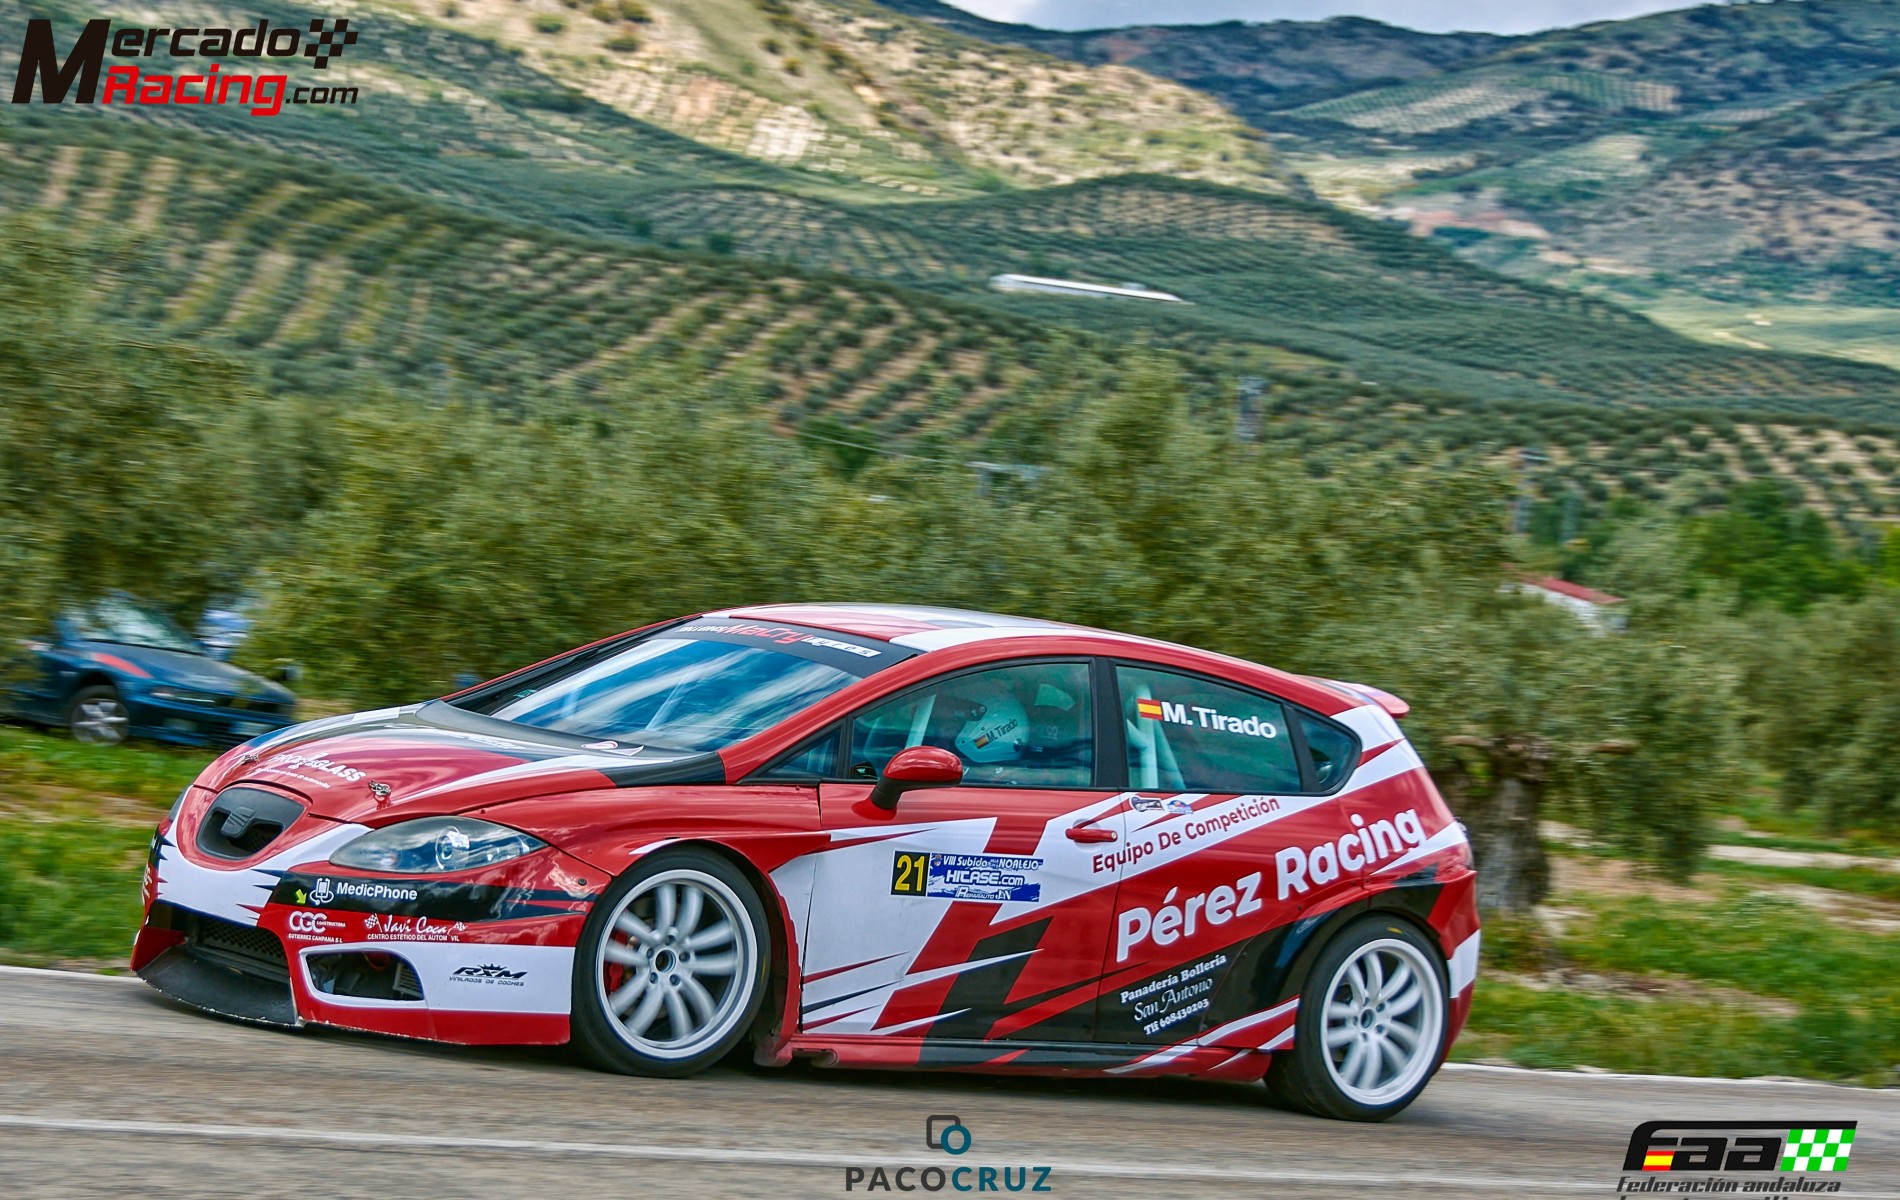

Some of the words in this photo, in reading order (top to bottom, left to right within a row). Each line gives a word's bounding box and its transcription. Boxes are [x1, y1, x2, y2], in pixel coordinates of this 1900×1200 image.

[994, 718, 1019, 737] Tirado
[1192, 706, 1277, 739] Tirado
[1092, 842, 1154, 874] Equipo
[1158, 830, 1181, 850] De
[1185, 797, 1281, 840] Competición
[894, 854, 925, 892] 21
[943, 855, 957, 866] VIII
[957, 856, 988, 868] Subida
[998, 858, 1039, 870] NOALEJO
[337, 882, 418, 901] MedicPhone
[1116, 871, 1262, 963] Pérez
[1275, 808, 1428, 901] Racing
[384, 914, 411, 933] Javi
[416, 915, 447, 935] Coca
[1134, 1002, 1159, 1021] San
[1159, 978, 1213, 1013] Antonio
